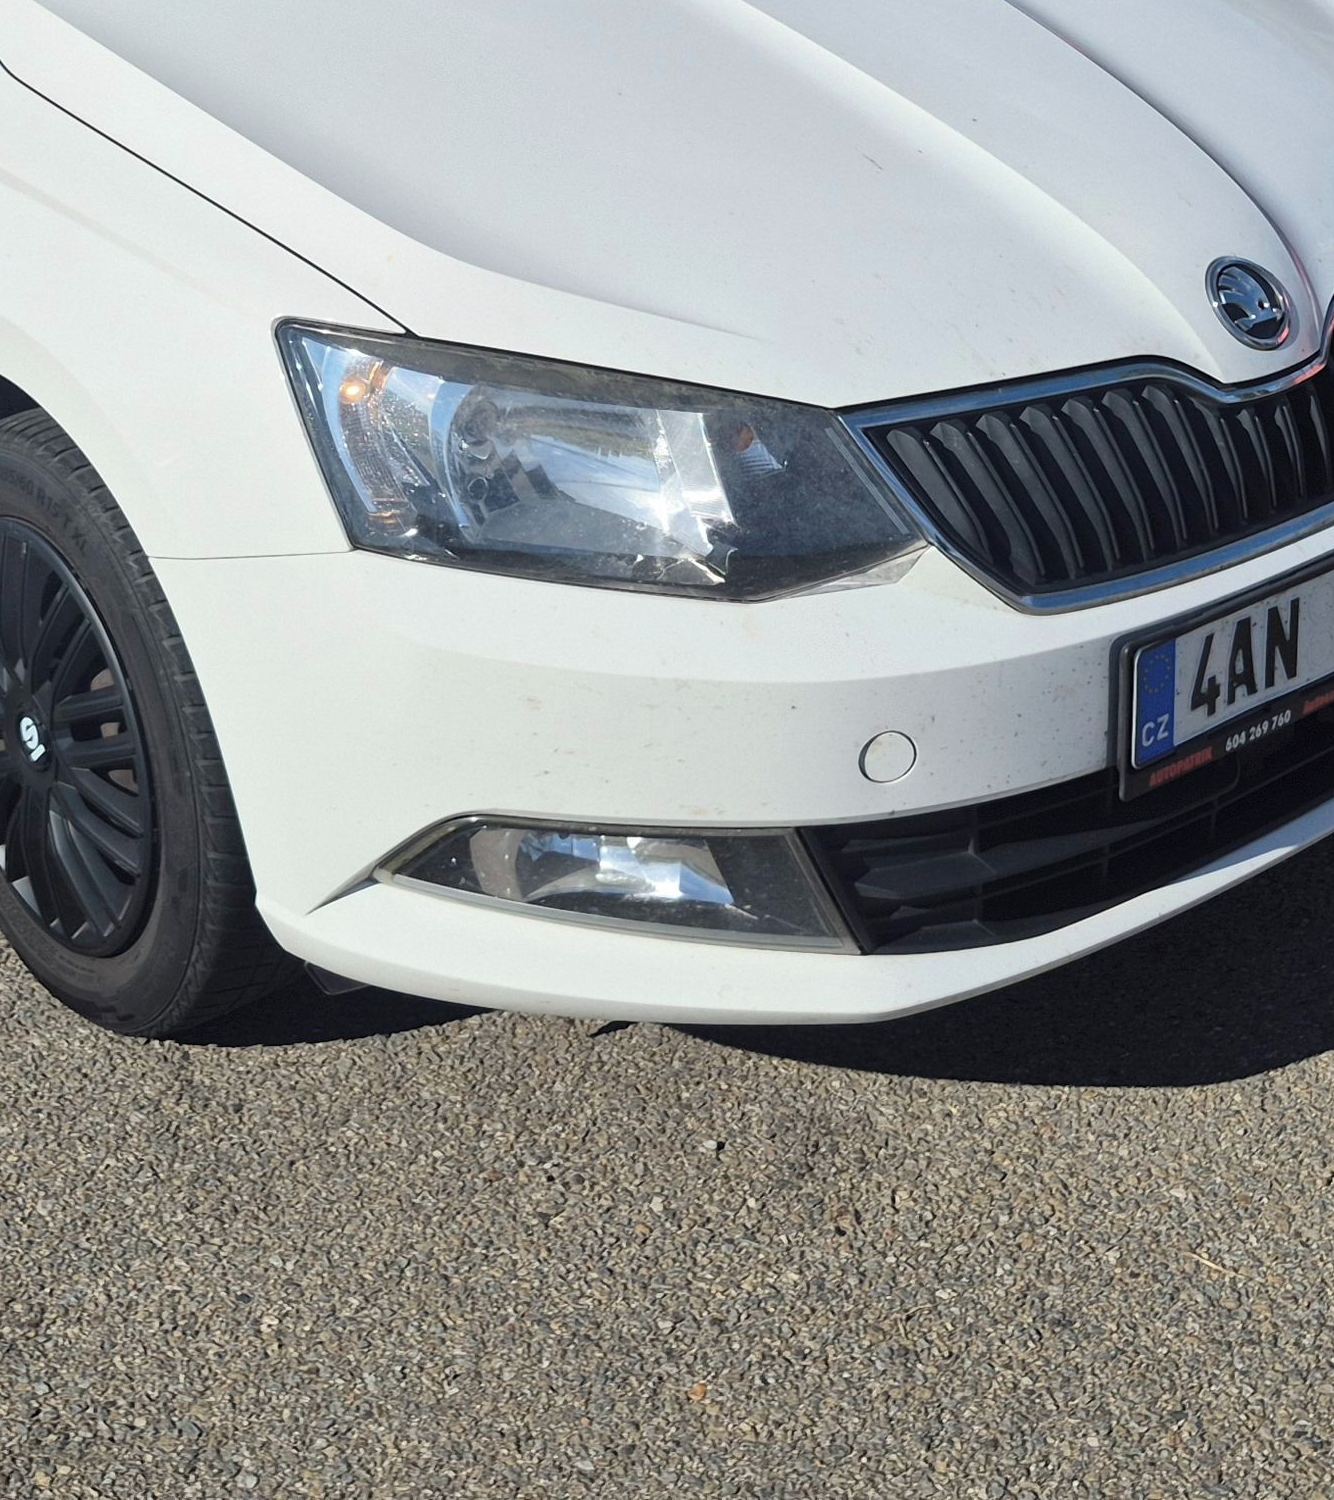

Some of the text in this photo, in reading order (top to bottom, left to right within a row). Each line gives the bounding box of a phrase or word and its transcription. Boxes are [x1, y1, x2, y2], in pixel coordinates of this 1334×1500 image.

[1190, 597, 1300, 717] 4AN
[1141, 713, 1170, 747] CZ
[1225, 731, 1247, 752] 604
[1249, 719, 1269, 742] 269
[1271, 709, 1292, 730] 760
